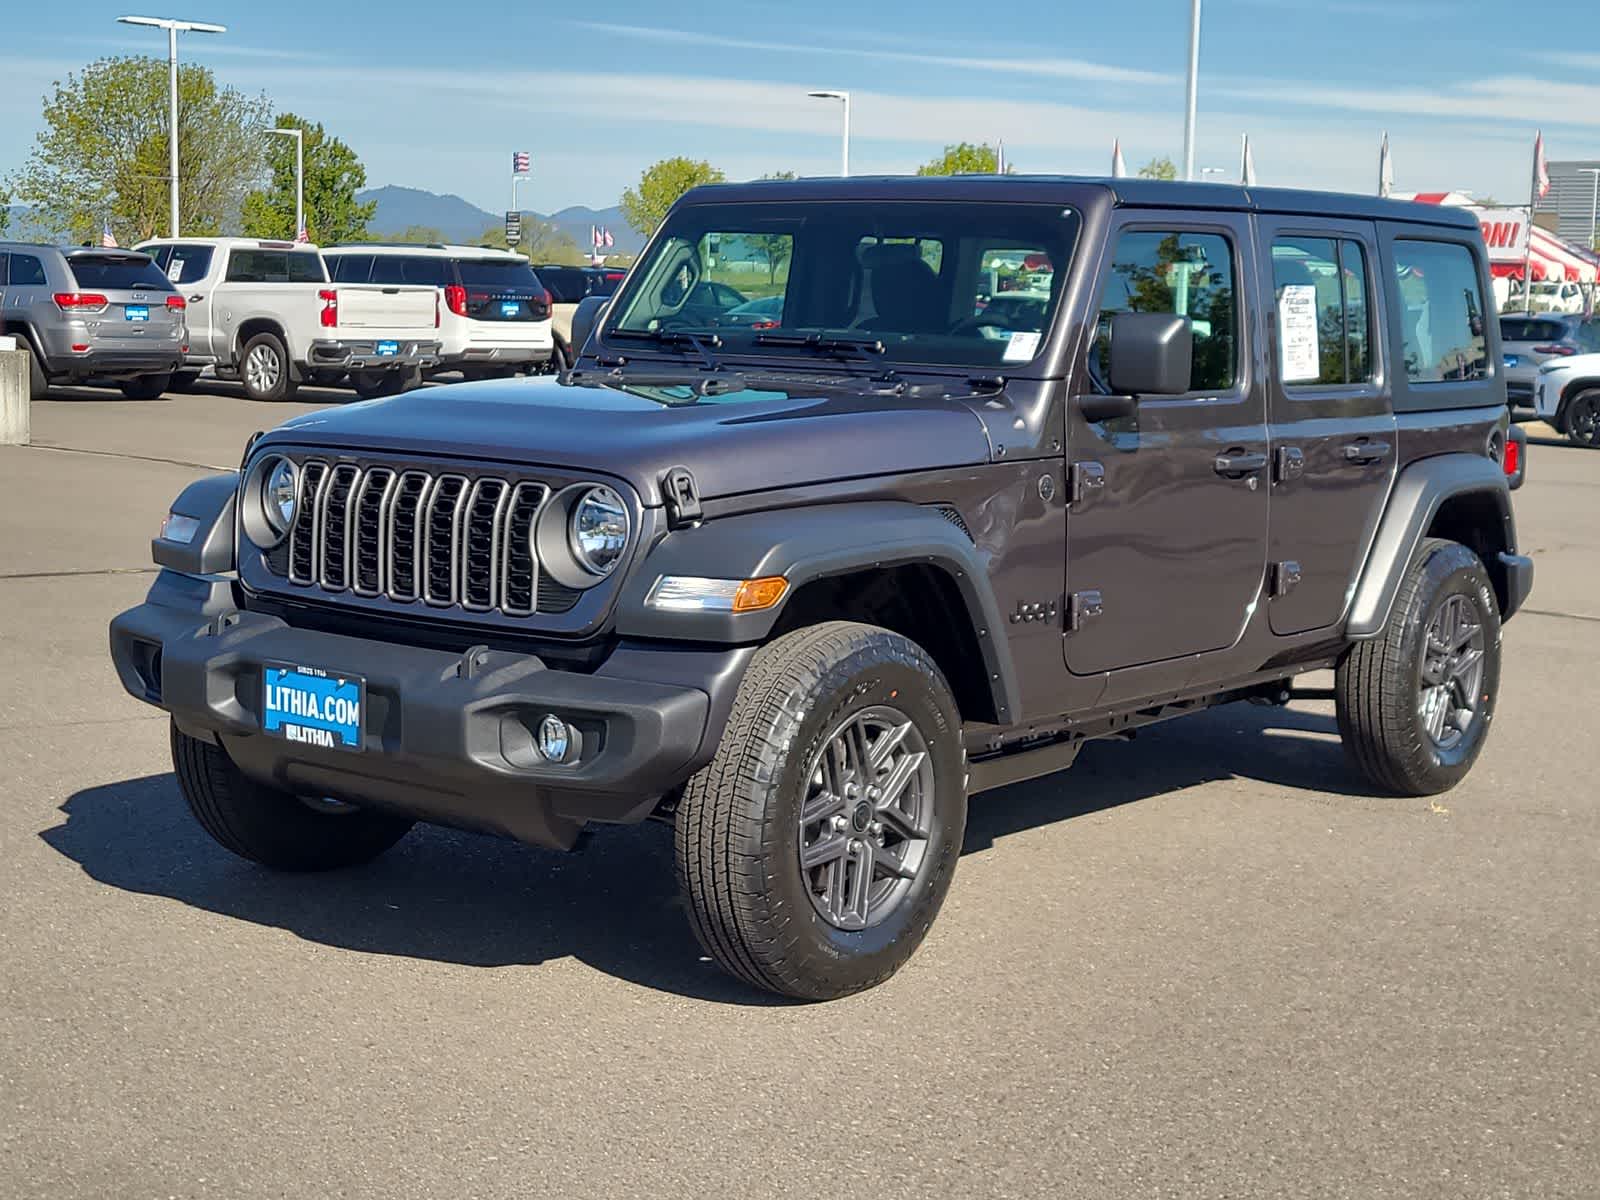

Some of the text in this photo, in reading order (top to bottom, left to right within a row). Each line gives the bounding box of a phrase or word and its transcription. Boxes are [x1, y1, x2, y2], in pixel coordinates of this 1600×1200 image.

[1009, 599, 1056, 625] Jeep
[266, 684, 360, 727] LITHIA.COM
[297, 725, 335, 748] LITHIA
